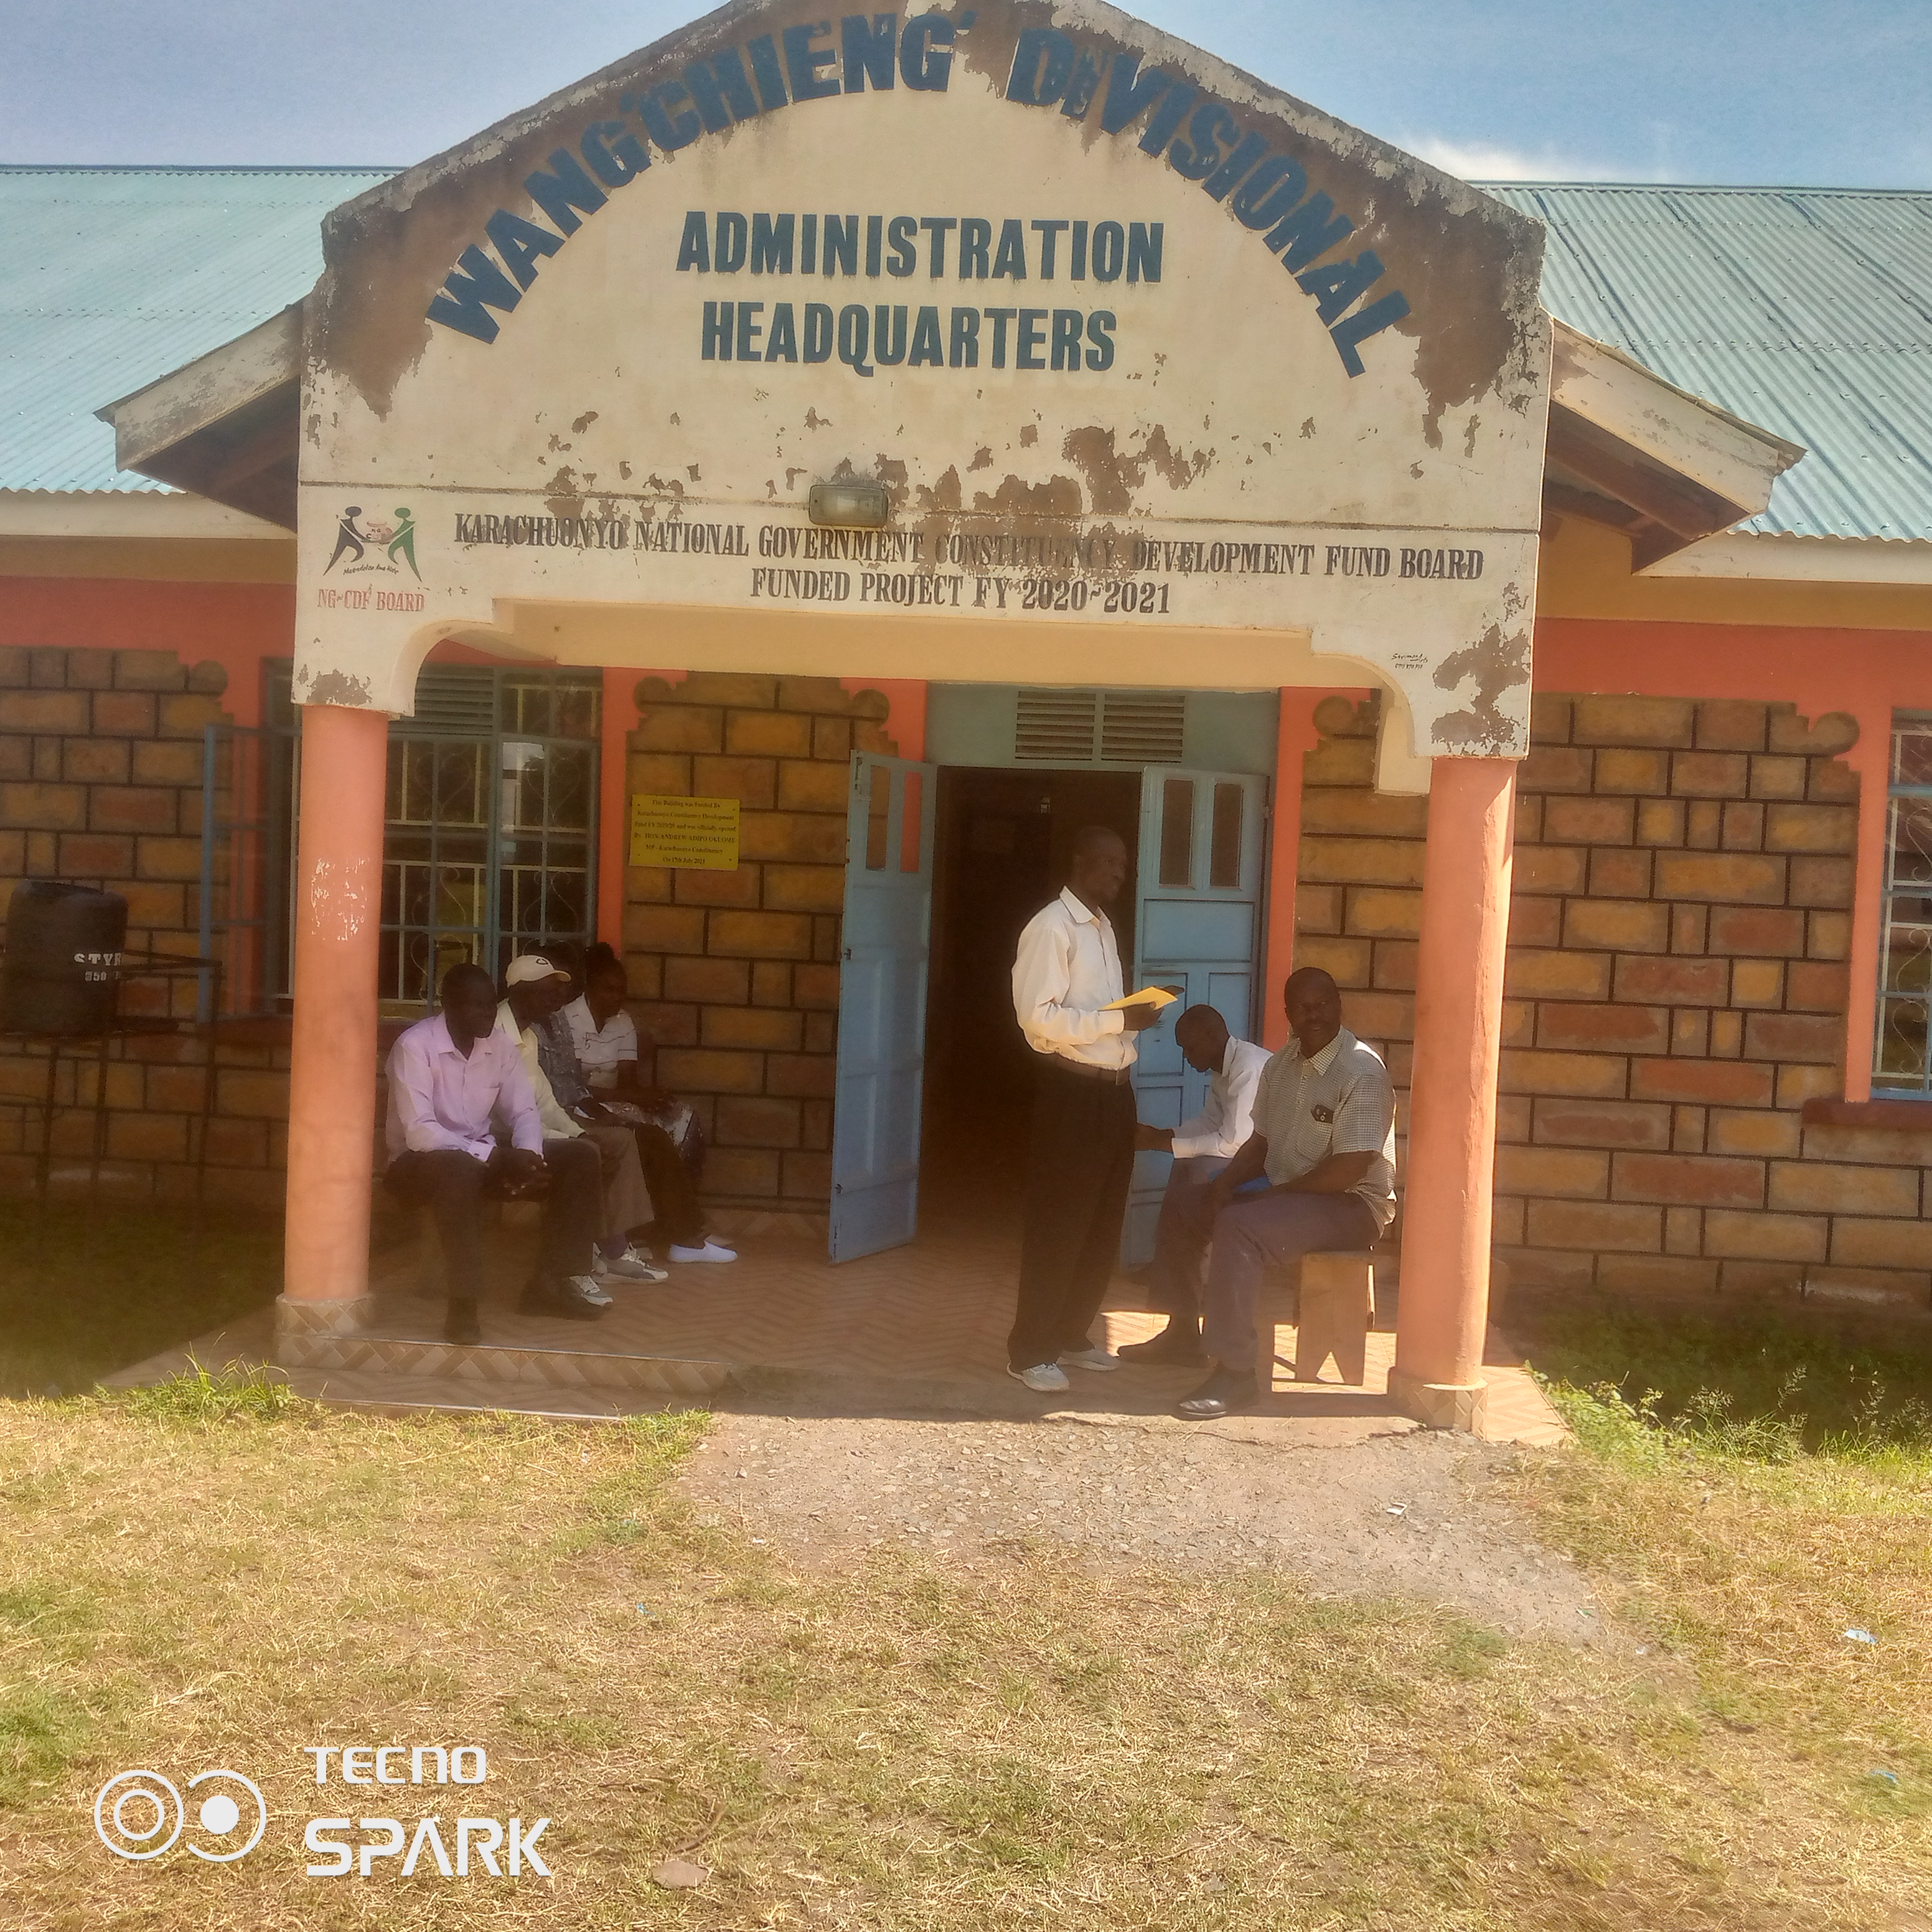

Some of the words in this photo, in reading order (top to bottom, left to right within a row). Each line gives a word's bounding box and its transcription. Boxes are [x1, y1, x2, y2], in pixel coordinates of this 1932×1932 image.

[1006, 29, 1411, 378] DIVISIONAL
[675, 211, 1165, 283] ADMINISTRATION
[701, 301, 1117, 378] HEADQUARTERS
[454, 513, 624, 551] KARACHUONYO
[634, 520, 749, 556] NATIONAL
[759, 524, 924, 564] GOVERNMENT
[1129, 540, 1315, 576] DEVELOPMENT
[1325, 545, 1391, 578] FUND
[1397, 548, 1484, 580] BOARD
[376, 591, 425, 612] BOARD
[750, 567, 850, 603] FUNDED
[860, 573, 964, 607] PROJECT
[974, 576, 1011, 609] FY
